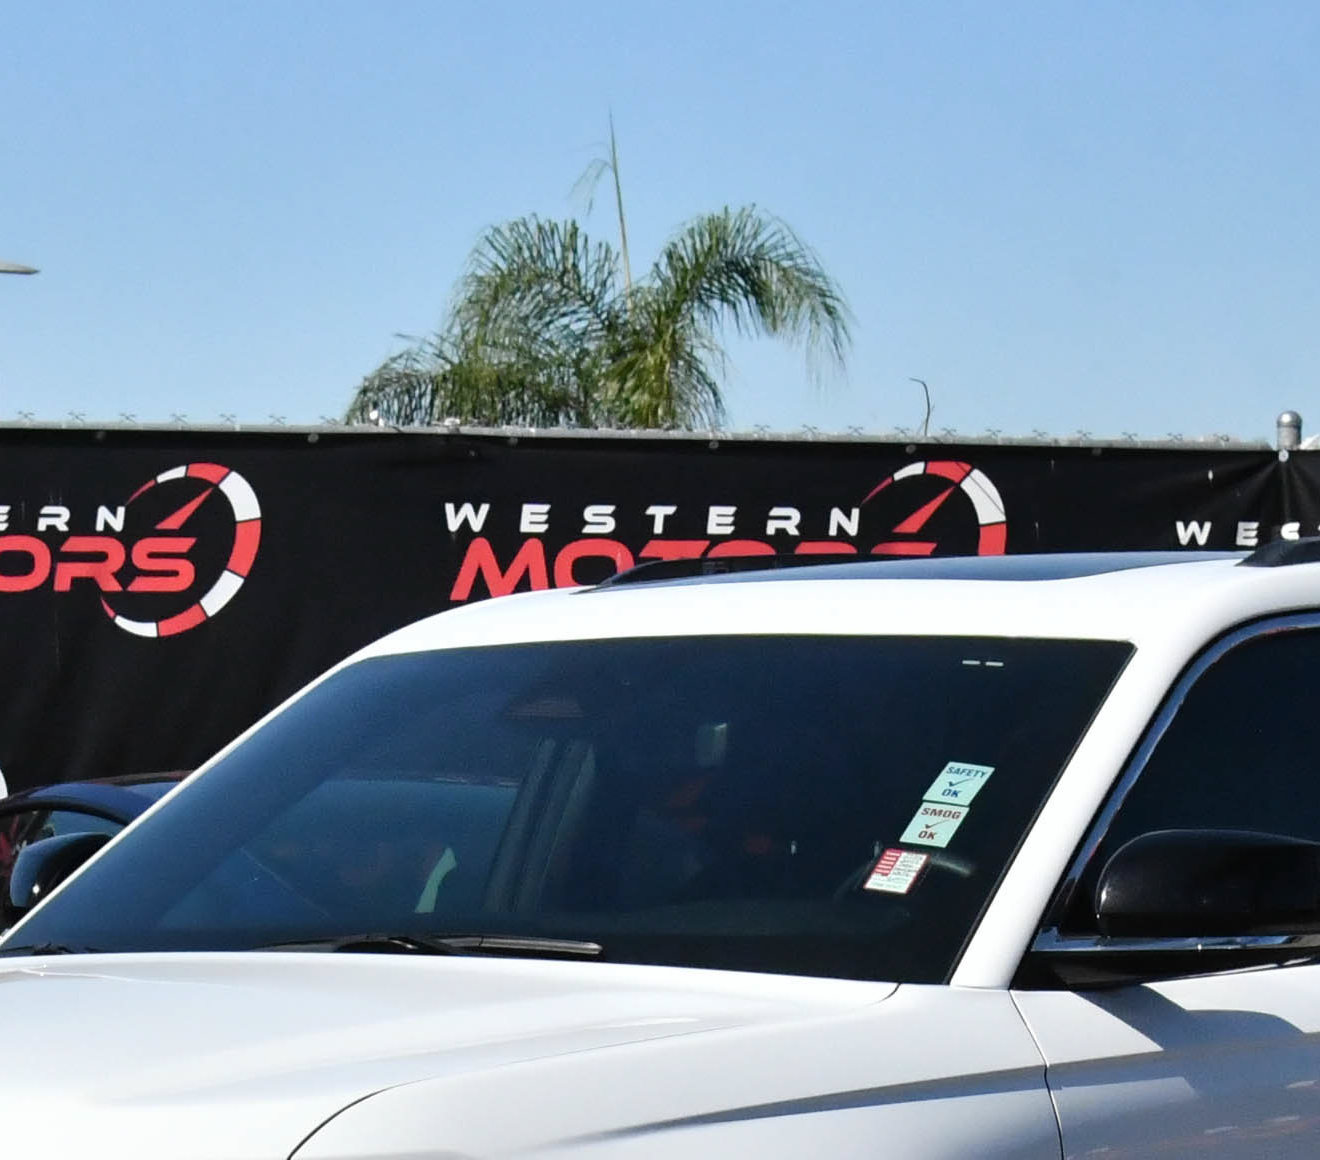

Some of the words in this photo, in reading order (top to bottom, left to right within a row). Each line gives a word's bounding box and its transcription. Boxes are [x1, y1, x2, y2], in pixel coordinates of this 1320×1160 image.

[444, 502, 860, 537] WESTERN
[946, 765, 987, 779] SAFETY
[941, 788, 962, 799] OK
[920, 807, 962, 820] SMOG
[918, 830, 937, 841] OK
